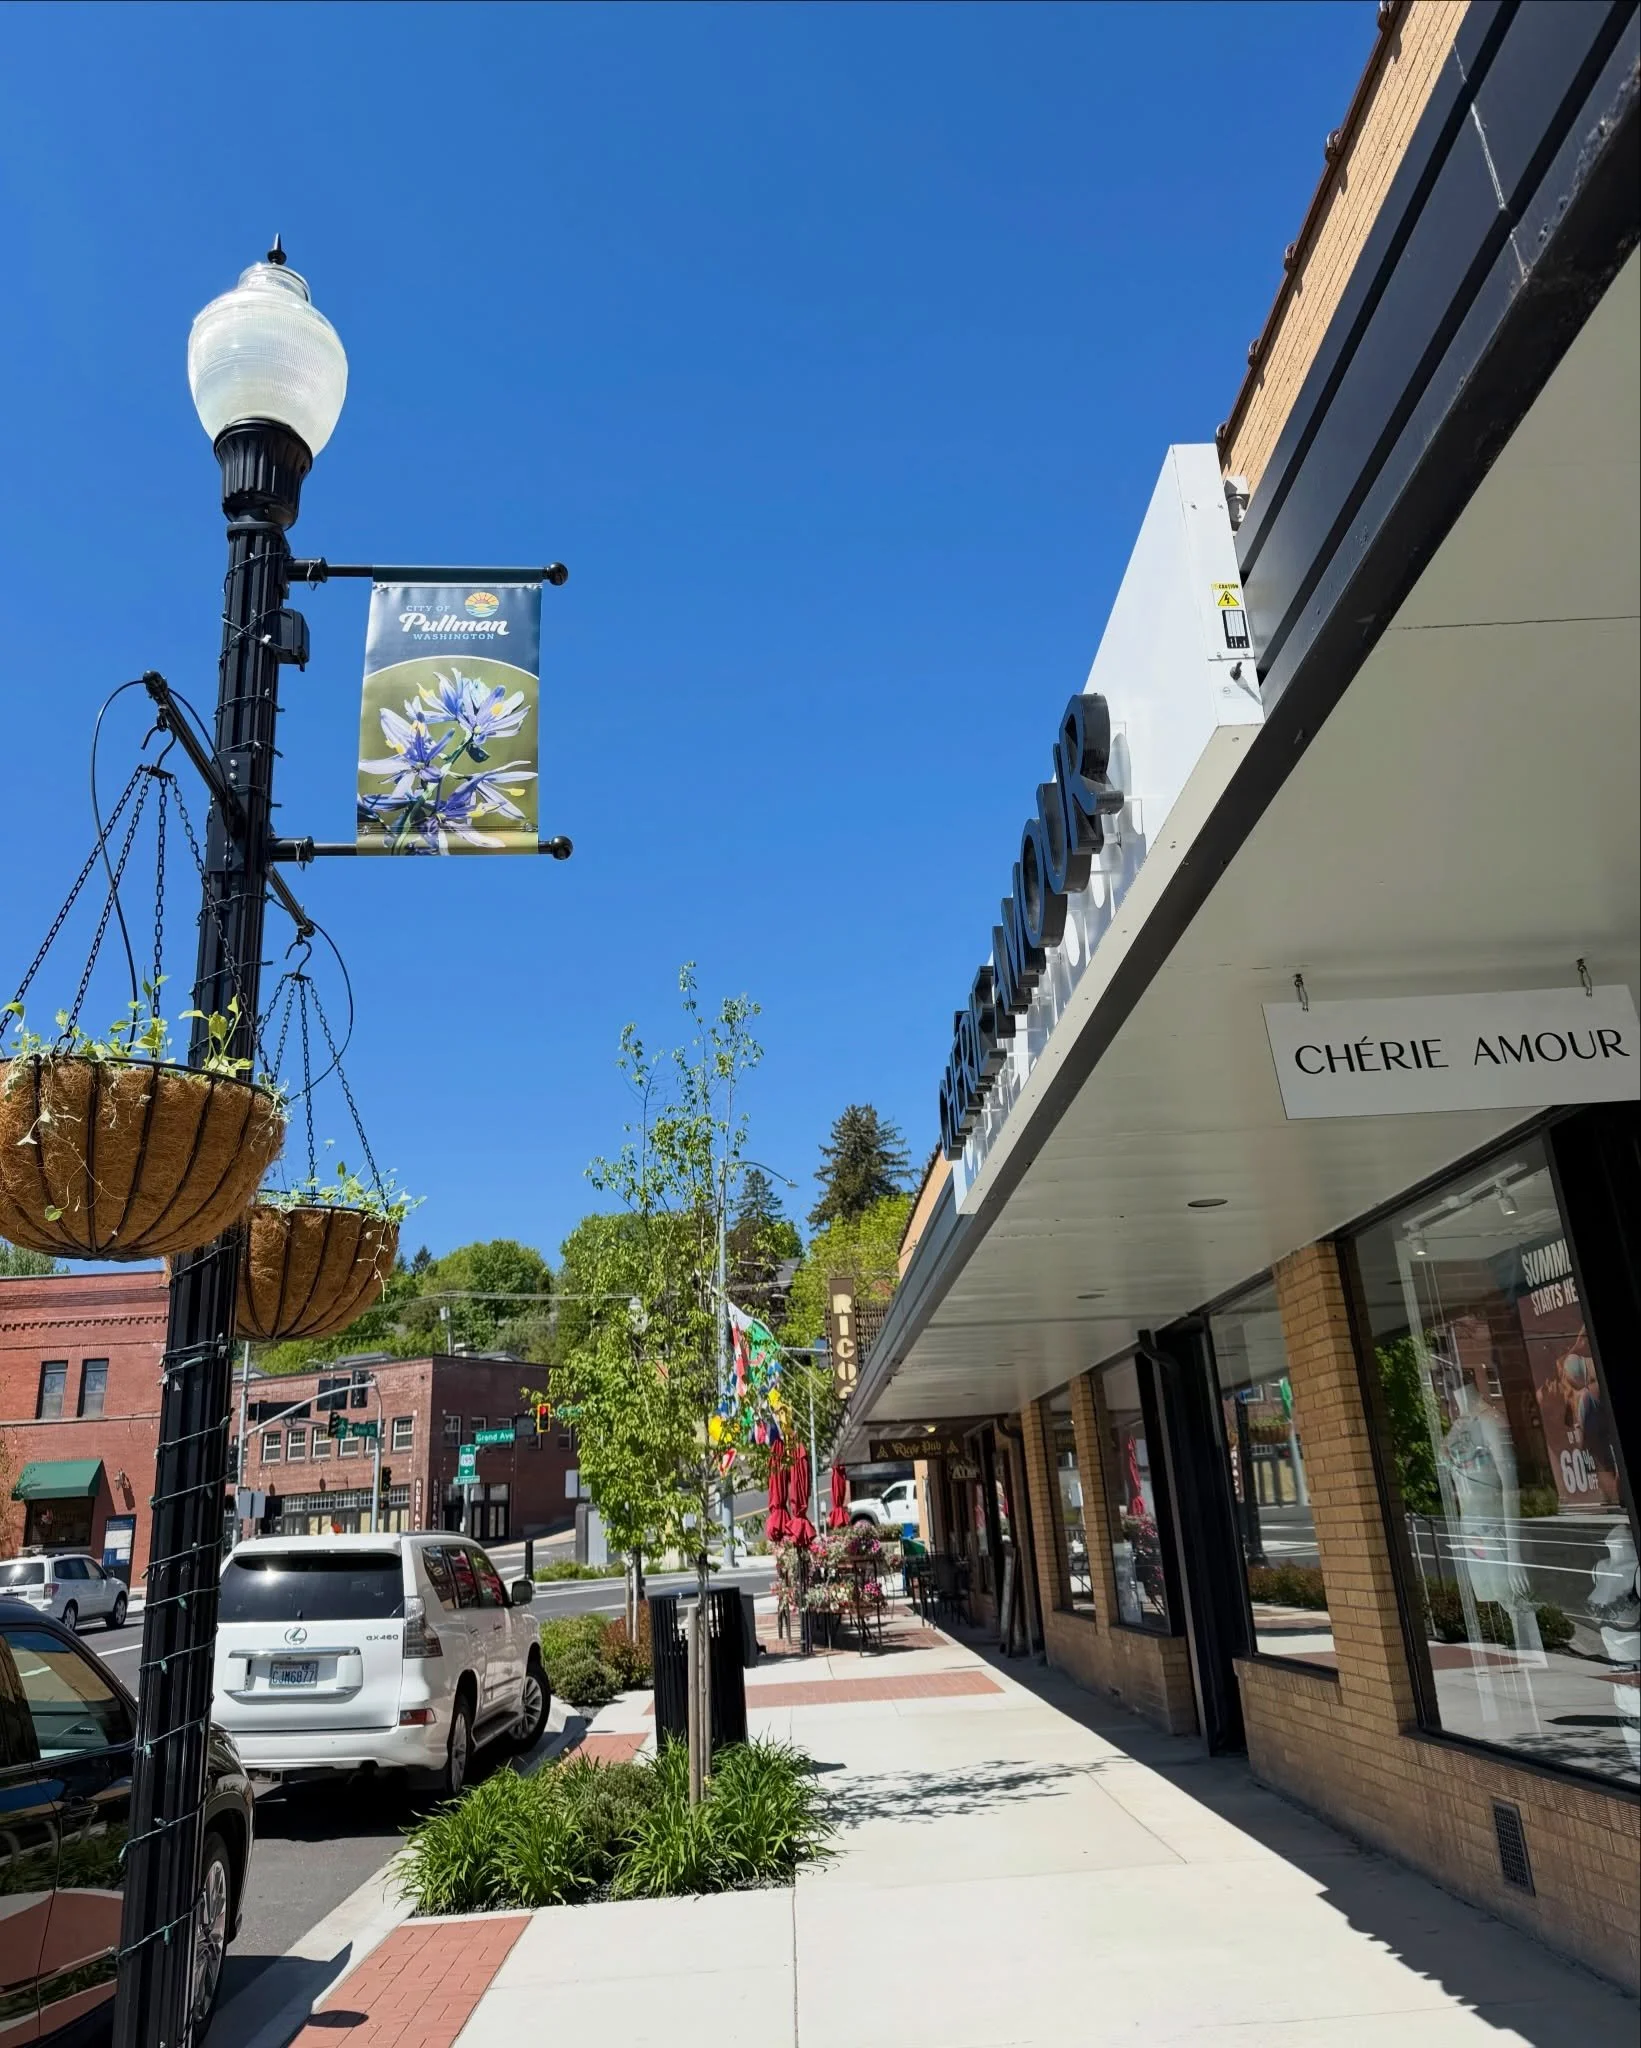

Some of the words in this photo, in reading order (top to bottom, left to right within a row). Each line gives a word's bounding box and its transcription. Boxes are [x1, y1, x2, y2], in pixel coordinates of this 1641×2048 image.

[399, 612, 510, 636] Pullman
[1294, 1036, 1449, 1075] CHÉRIE
[1474, 1029, 1631, 1067] AMOUR
[1531, 1283, 1564, 1317] STARTS
[1563, 1277, 1579, 1305] HE
[477, 1432, 498, 1442] Grand
[500, 1431, 514, 1440] Ave
[1560, 1447, 1596, 1494] 60%
